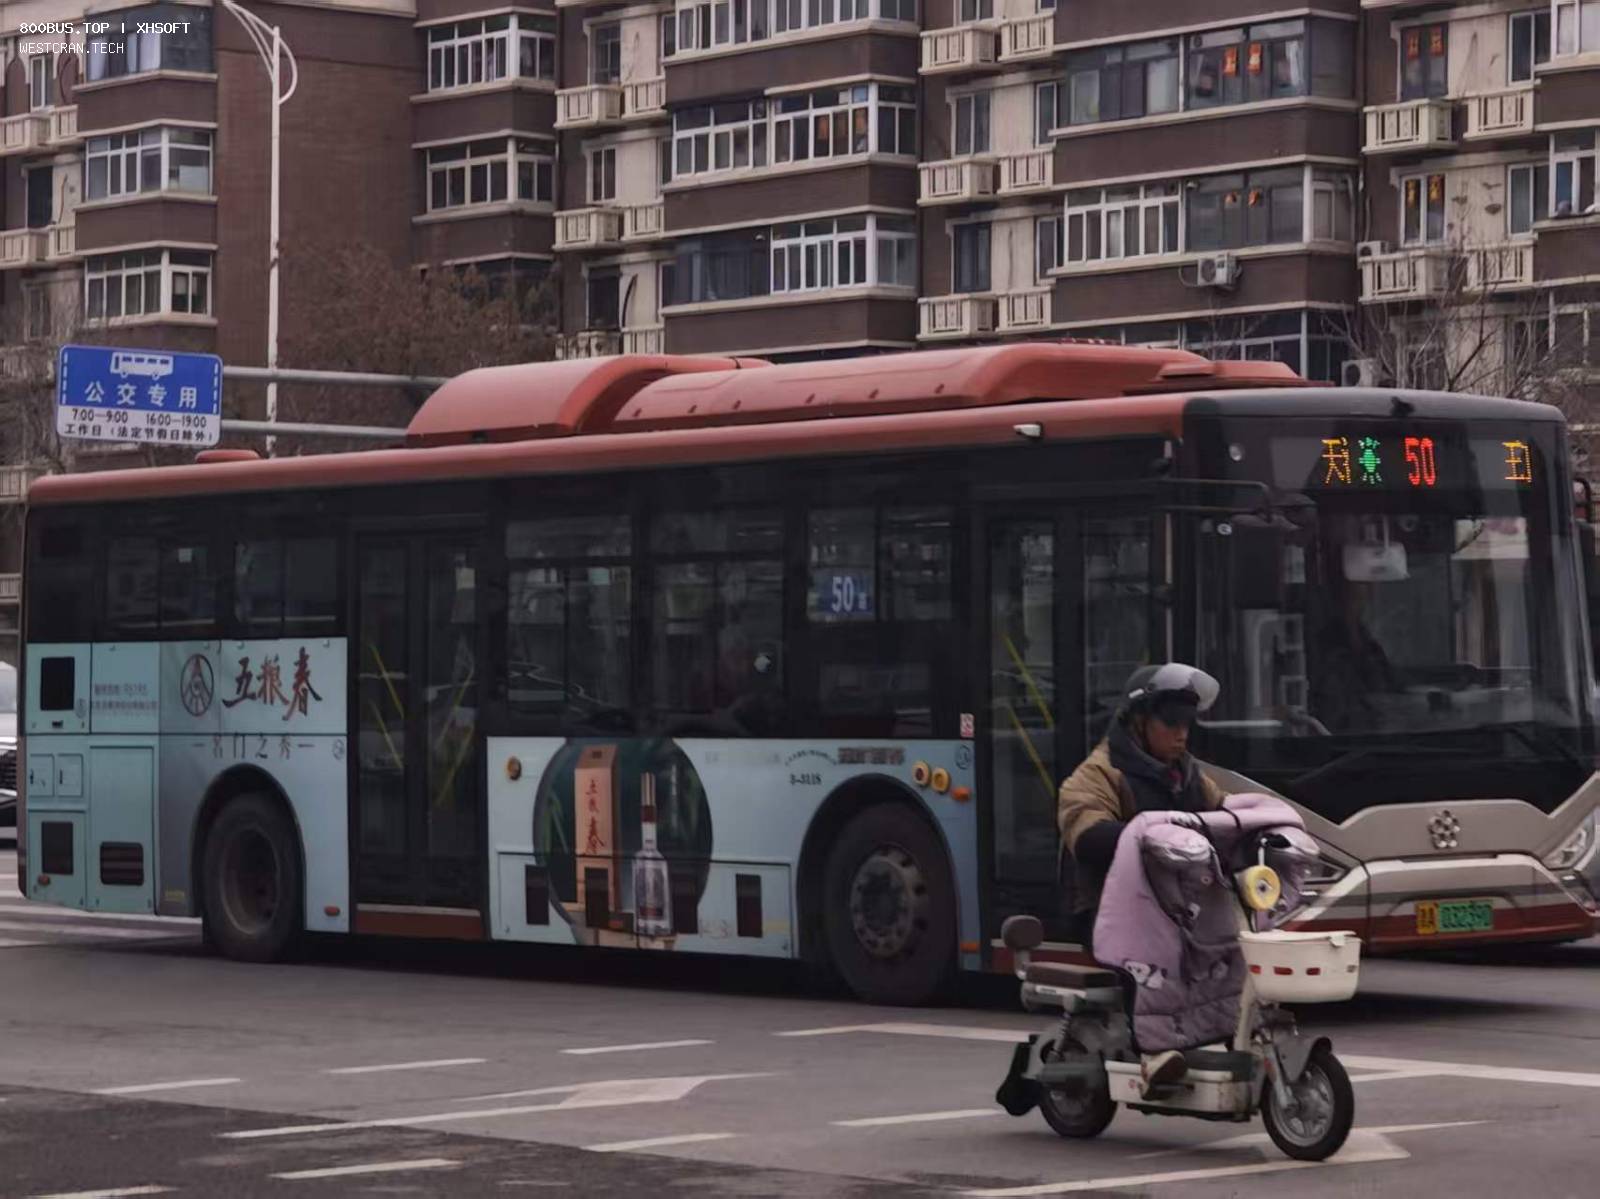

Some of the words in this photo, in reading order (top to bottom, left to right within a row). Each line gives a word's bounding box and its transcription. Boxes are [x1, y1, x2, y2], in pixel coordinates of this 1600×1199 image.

[85, 381, 197, 408] 公交专用
[1404, 437, 1436, 486] 50
[222, 646, 322, 721] 五粮春
